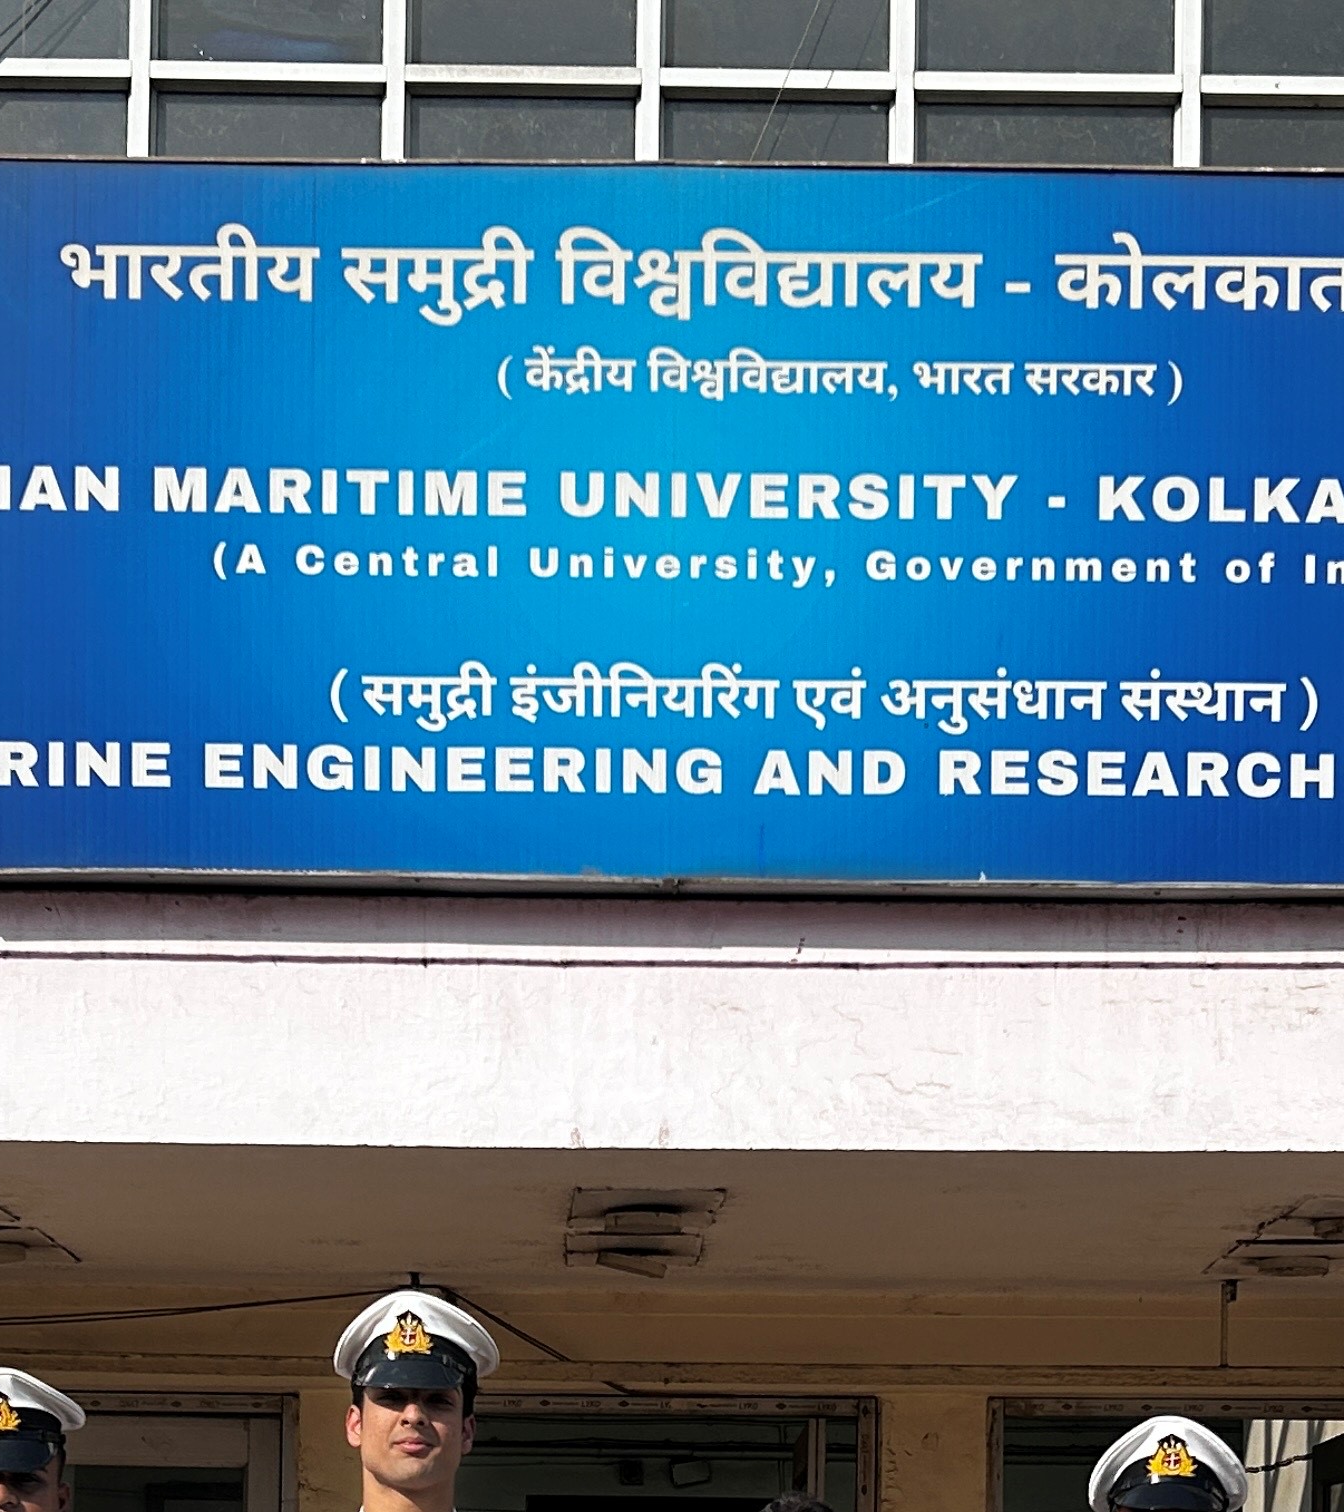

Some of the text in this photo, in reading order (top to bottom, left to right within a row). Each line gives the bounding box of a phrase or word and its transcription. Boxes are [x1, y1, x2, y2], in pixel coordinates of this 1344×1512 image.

[60, 221, 321, 302] भारतीय
[341, 225, 535, 327] समुद्री
[554, 226, 984, 321] विश्वविद्यालय
[524, 345, 637, 395] केंद्रीय
[646, 346, 898, 401] विश्वविद्यालय,
[912, 361, 1015, 395] भारत
[1024, 362, 1158, 397] सरकार
[153, 466, 527, 517] MARITIME
[560, 471, 1018, 520] UNIVERSITY
[213, 541, 266, 580] (A
[295, 544, 498, 578] Central
[529, 546, 835, 589] University,
[865, 550, 1197, 583] Government
[1225, 551, 1275, 584] of
[361, 660, 498, 731] समुद्री
[509, 661, 781, 723] इंजीनियरिंग
[792, 666, 864, 730] एवं
[880, 667, 1108, 737] अनुसंधान
[1119, 668, 1287, 723] संस्थान
[204, 743, 723, 795] ENGINEERING
[753, 749, 906, 796] AND
[939, 749, 1335, 799] RESEARCH
